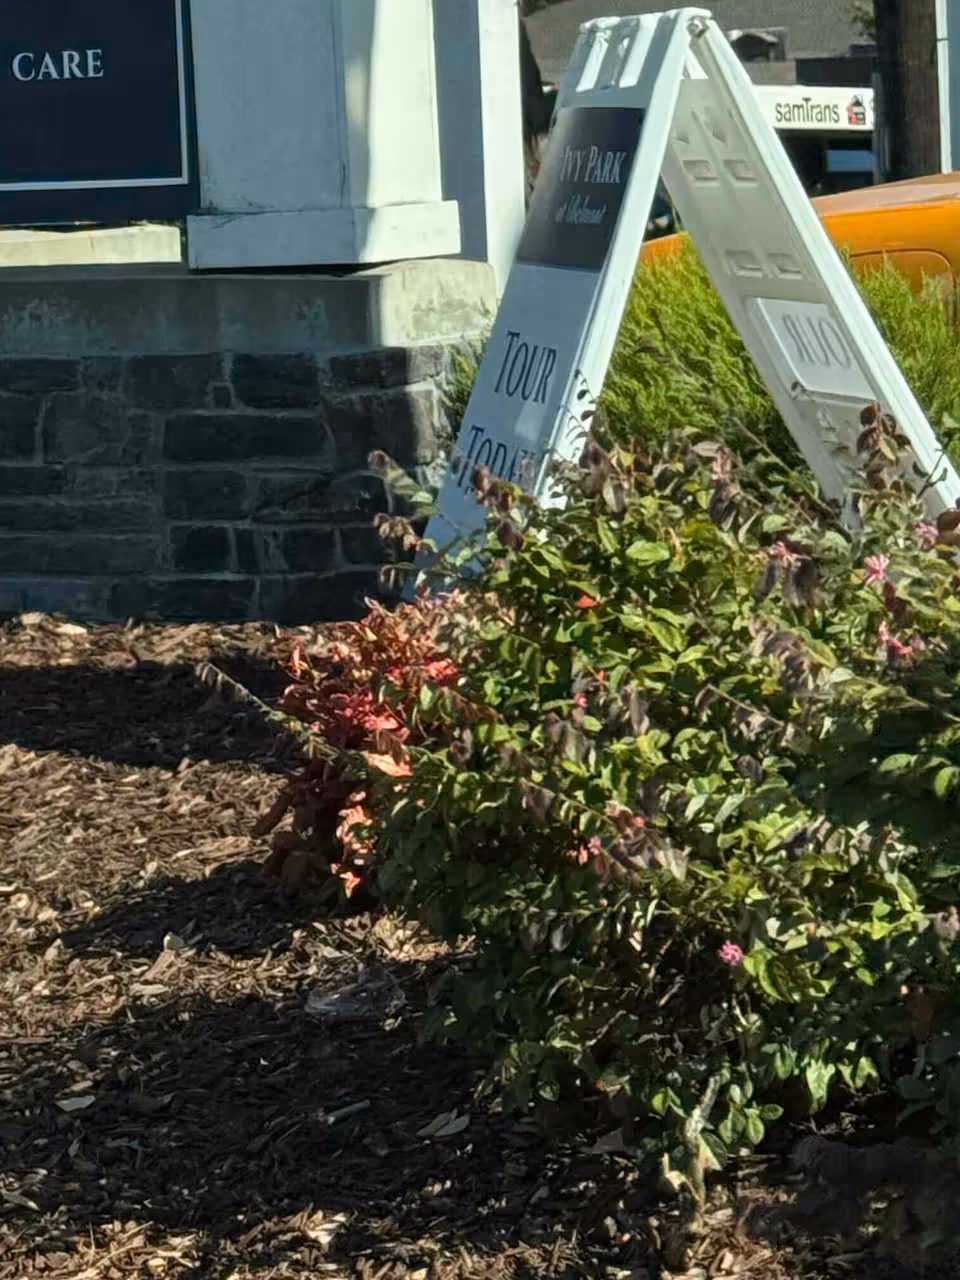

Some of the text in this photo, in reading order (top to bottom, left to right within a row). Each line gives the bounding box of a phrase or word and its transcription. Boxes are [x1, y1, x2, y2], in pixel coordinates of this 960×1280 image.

[11, 48, 105, 82] CARE
[775, 96, 840, 123] samTrans
[494, 330, 557, 404] TOUR
